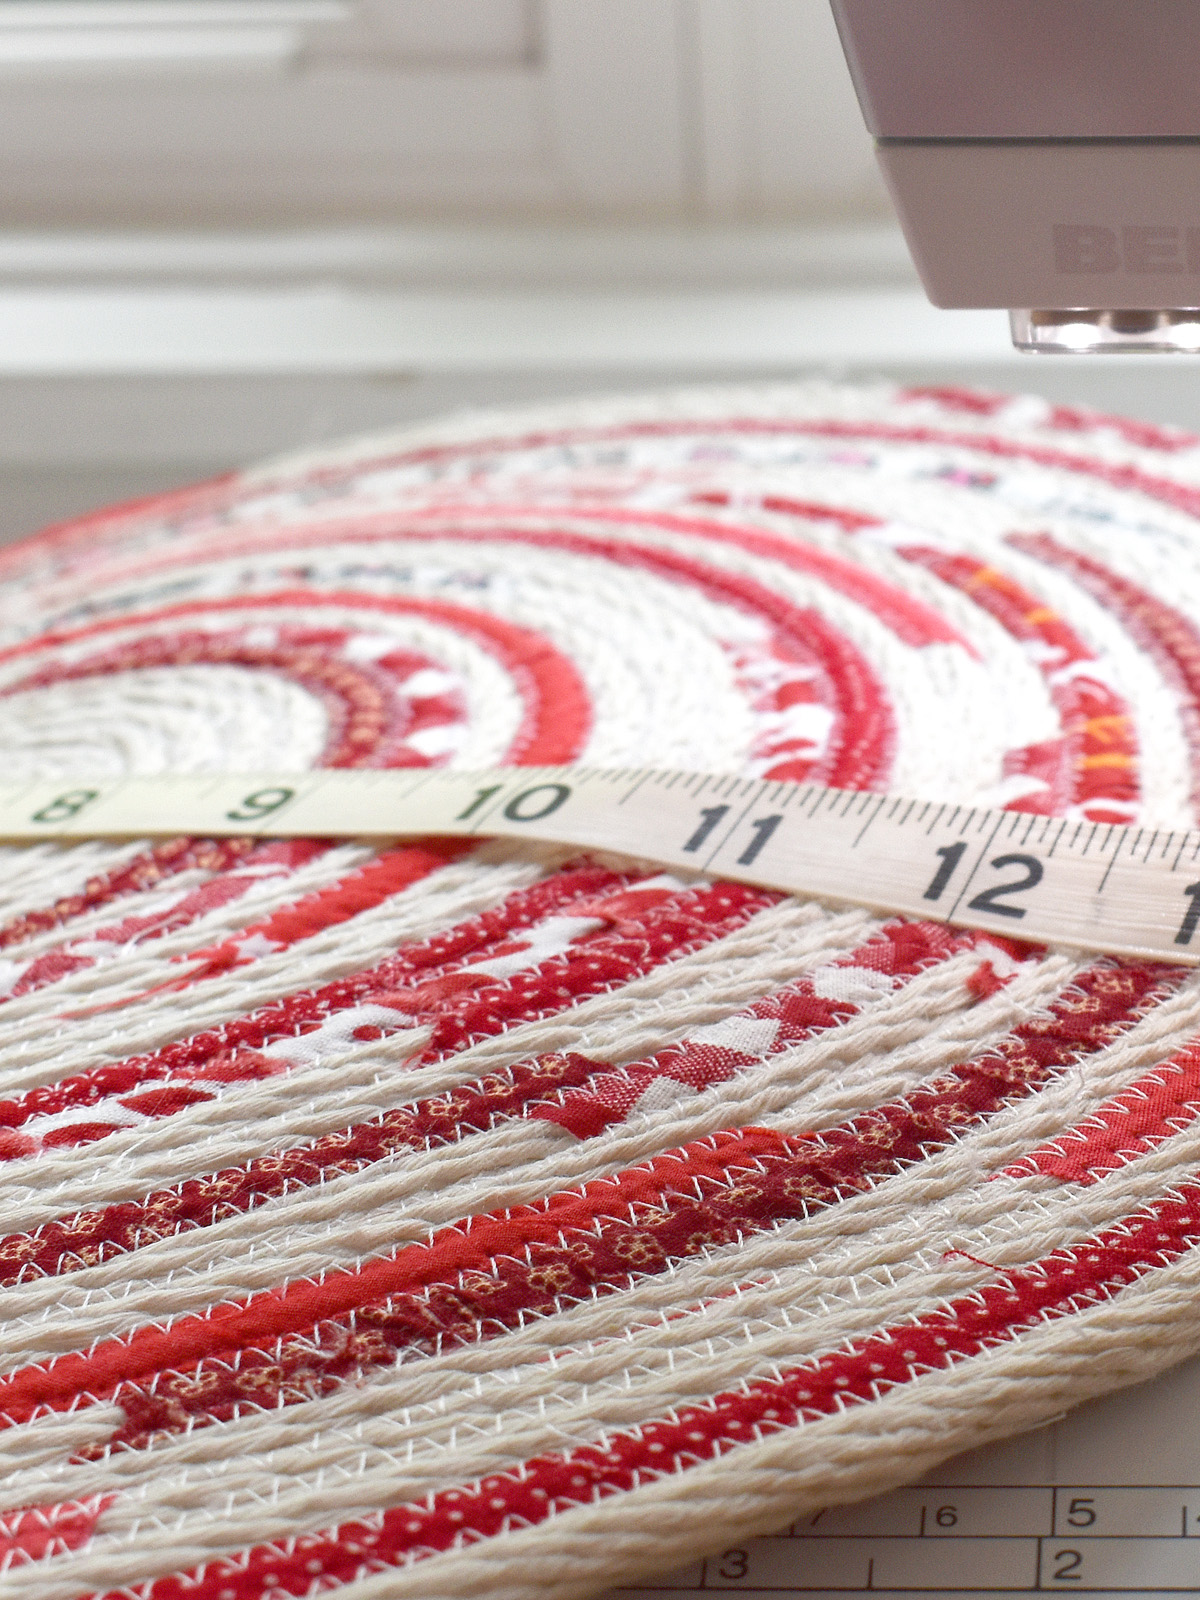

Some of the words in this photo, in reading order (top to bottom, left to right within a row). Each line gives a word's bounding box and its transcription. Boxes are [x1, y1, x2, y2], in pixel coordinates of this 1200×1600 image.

[31, 787, 98, 823] 8
[225, 786, 295, 821] 9
[456, 783, 572, 822] 10
[682, 803, 784, 865] 11
[922, 841, 1045, 919] 12
[935, 1504, 958, 1527] 6
[1066, 1498, 1097, 1528] 5
[719, 1549, 749, 1580] 3
[1052, 1549, 1082, 1580] 2
